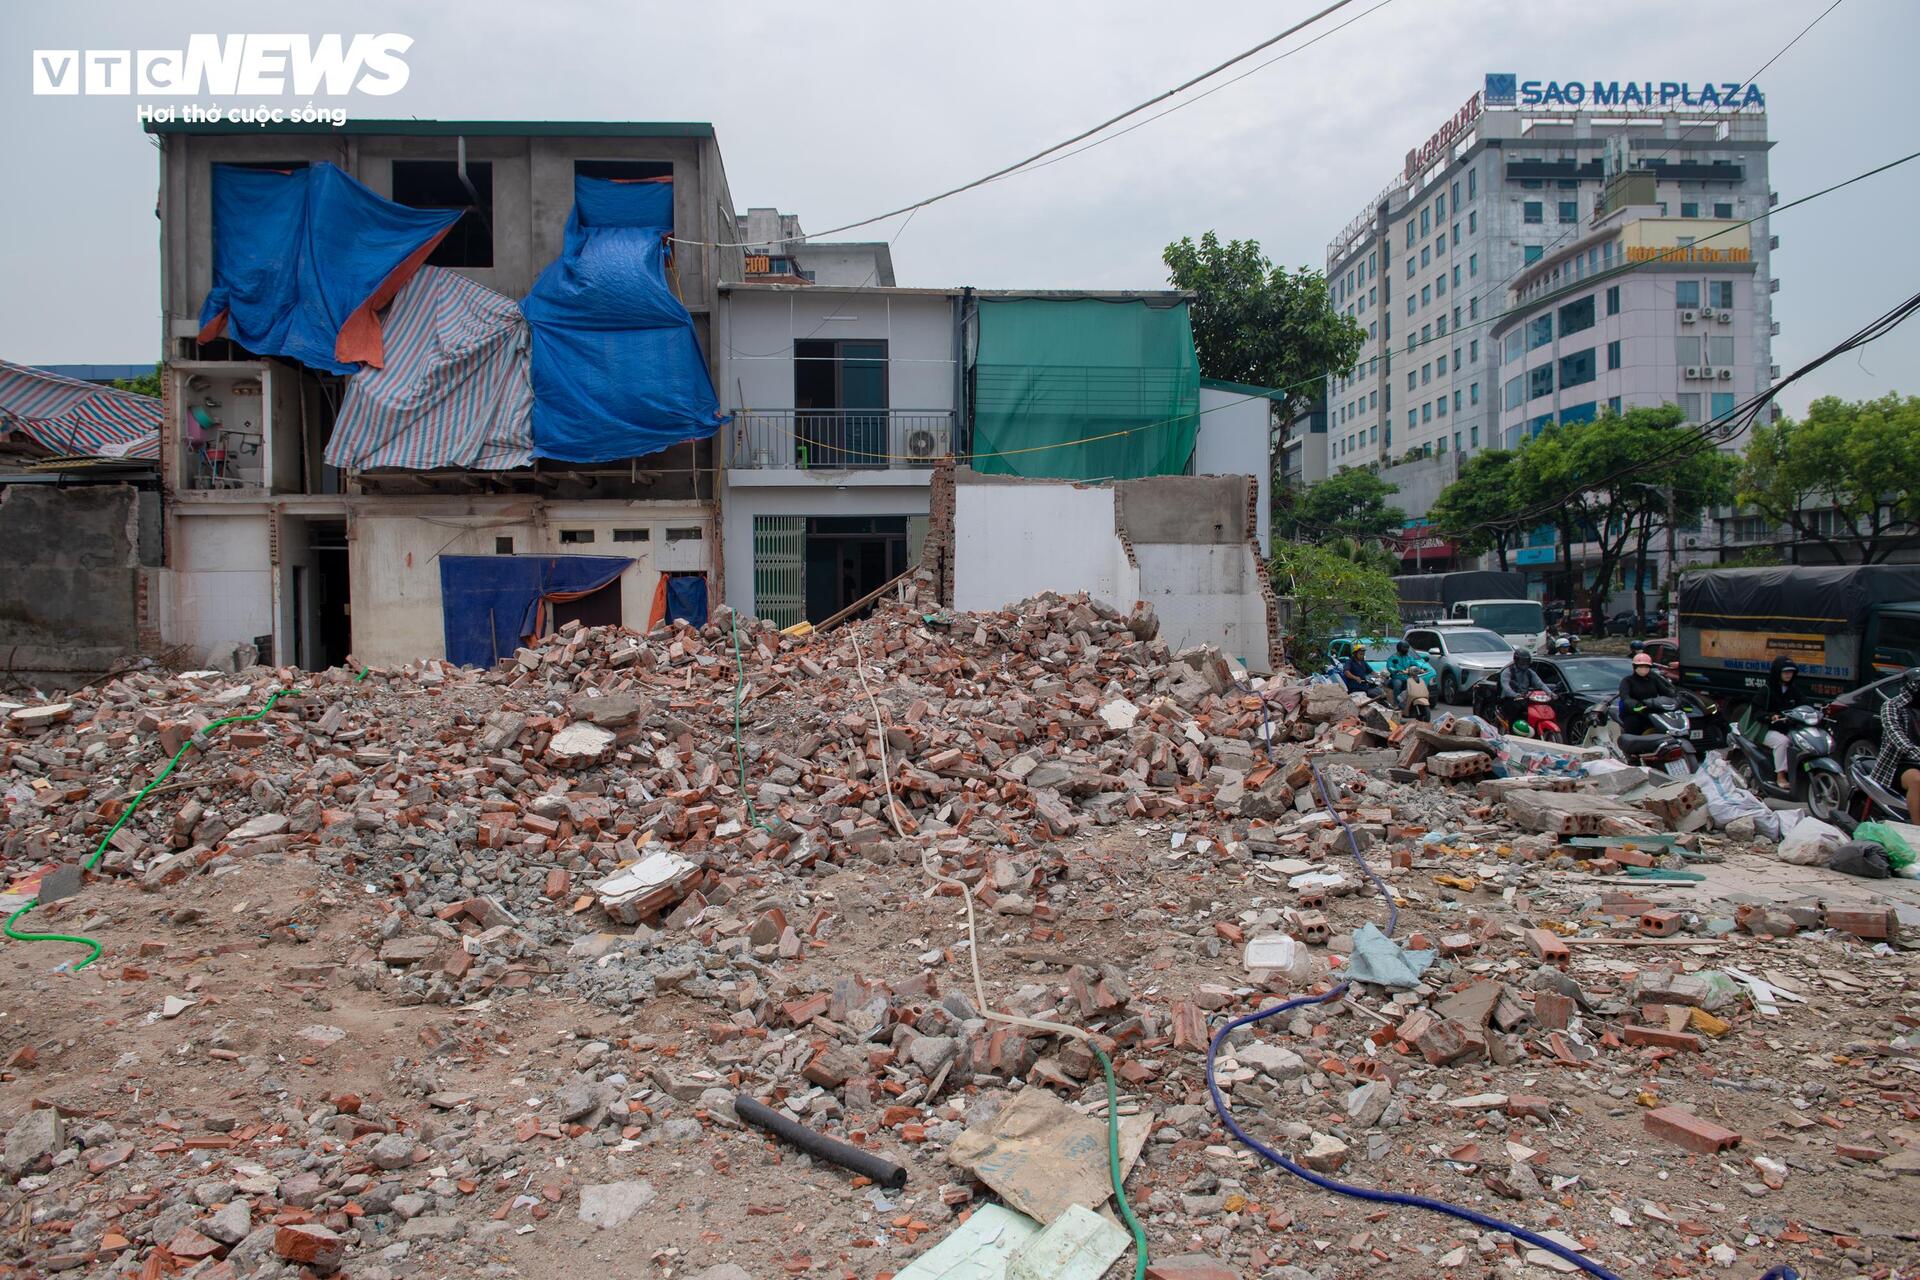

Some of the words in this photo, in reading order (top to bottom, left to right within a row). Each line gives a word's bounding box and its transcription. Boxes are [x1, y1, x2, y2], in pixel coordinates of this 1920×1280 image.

[1521, 81, 1585, 104] SAO
[1593, 82, 1650, 105] MAI
[1660, 82, 1765, 106] PLAZA
